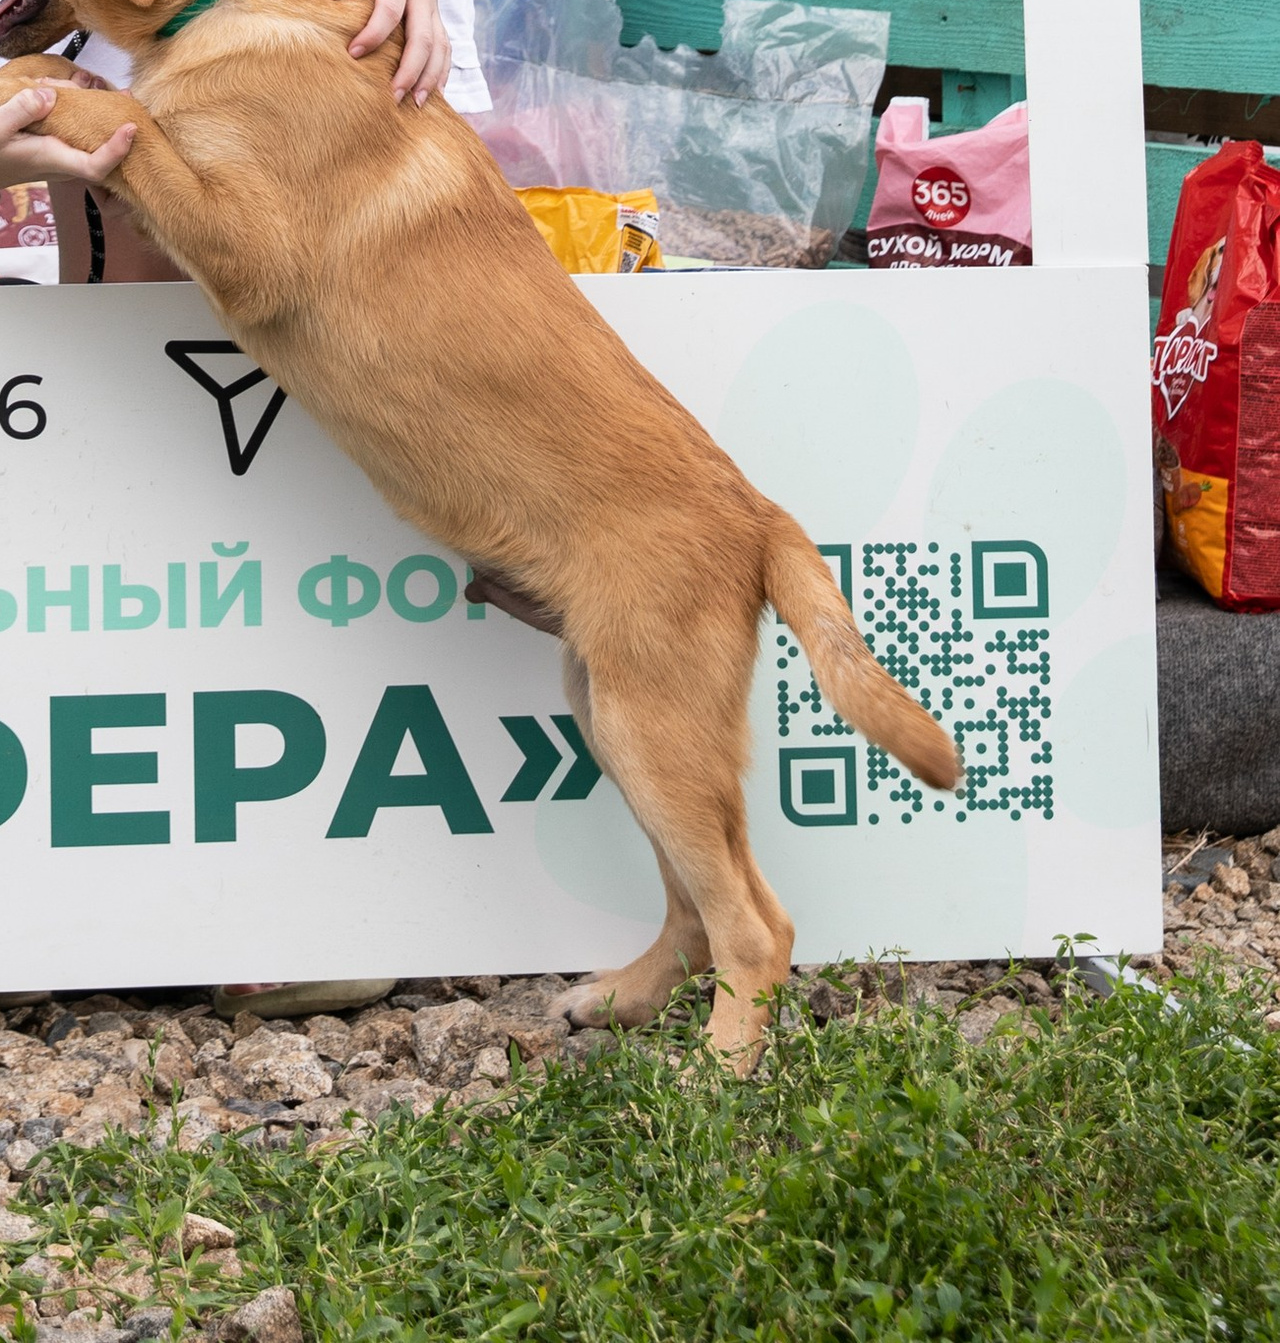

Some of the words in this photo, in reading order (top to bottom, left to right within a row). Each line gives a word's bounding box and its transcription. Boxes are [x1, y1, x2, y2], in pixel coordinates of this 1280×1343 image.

[914, 179, 969, 207] 365
[867, 232, 944, 260] СУХОЙ
[948, 242, 1014, 267] КОРМ
